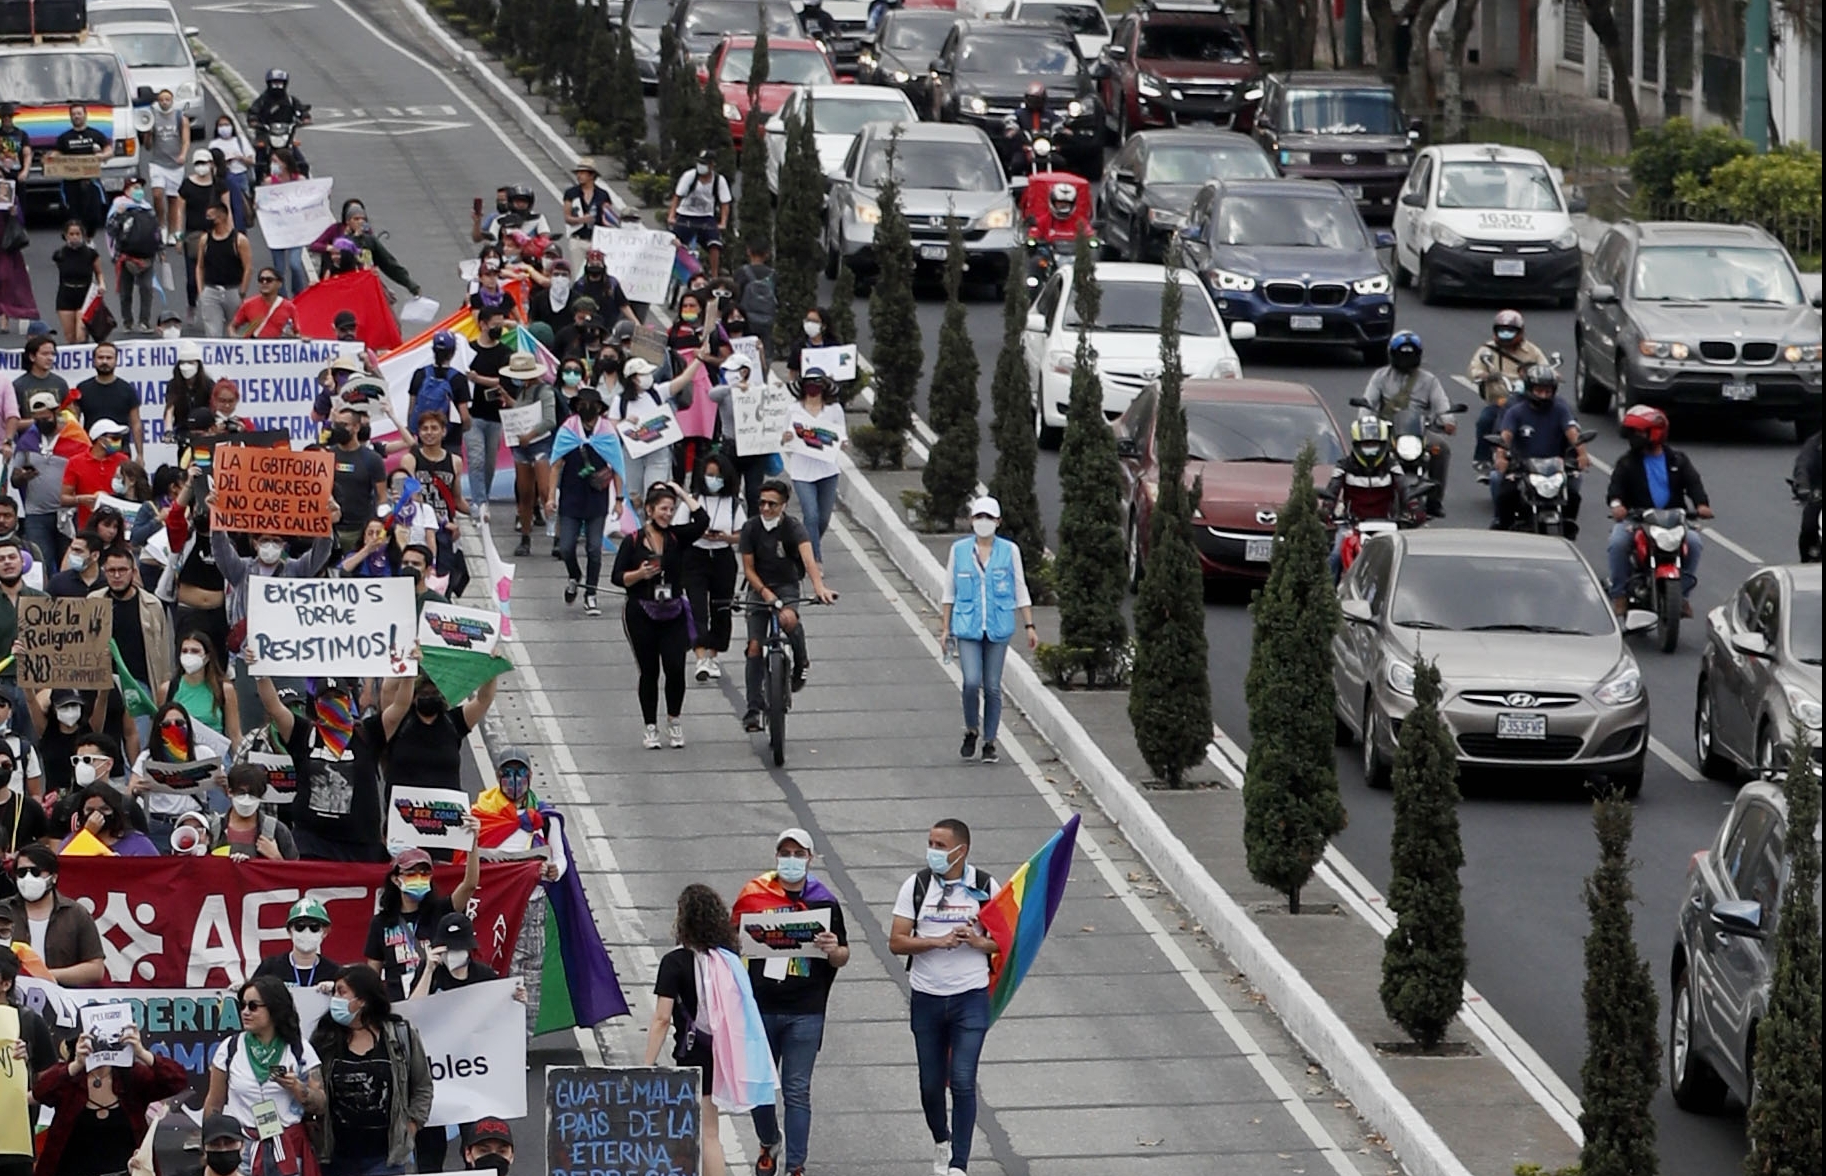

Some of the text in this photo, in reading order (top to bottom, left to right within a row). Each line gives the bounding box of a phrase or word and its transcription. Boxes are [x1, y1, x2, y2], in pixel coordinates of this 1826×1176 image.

[253, 342, 340, 364] LESBIANAS
[220, 451, 327, 477] LA LGBTFOBIA
[219, 473, 322, 496] DEL CONGRESO
[226, 495, 319, 513] NO CABE EN
[215, 513, 329, 533] NUESTRAS CALLES
[67, 604, 80, 625] la
[24, 627, 85, 651] Religión
[255, 623, 397, 662] RESISTIMOS!
[24, 654, 51, 683] NO
[79, 652, 103, 667] LEY
[556, 1078, 697, 1109] GUATEMALA
[556, 1107, 696, 1142] PAÍS DE LA
[569, 1140, 673, 1170] ETERNA
